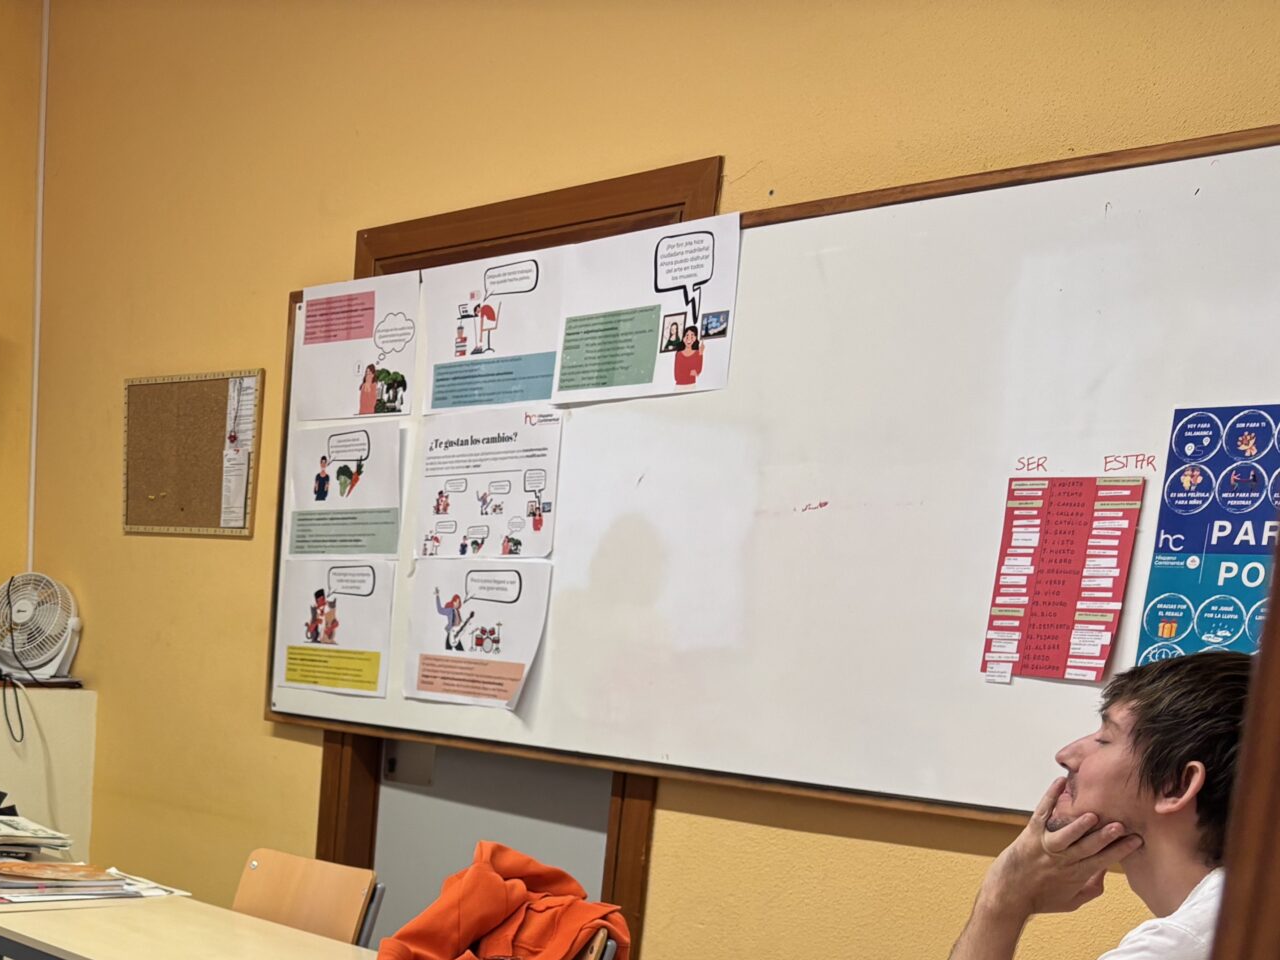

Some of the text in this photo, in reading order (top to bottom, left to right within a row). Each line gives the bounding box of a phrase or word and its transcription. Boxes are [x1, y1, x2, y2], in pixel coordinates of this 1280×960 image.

[429, 432, 518, 452] ¿Te gustan los cambios?
[1015, 454, 1157, 472] SER ESTAR
[1159, 529, 1185, 551] hc
[1211, 520, 1278, 546] PAR
[1217, 561, 1266, 588] PO
